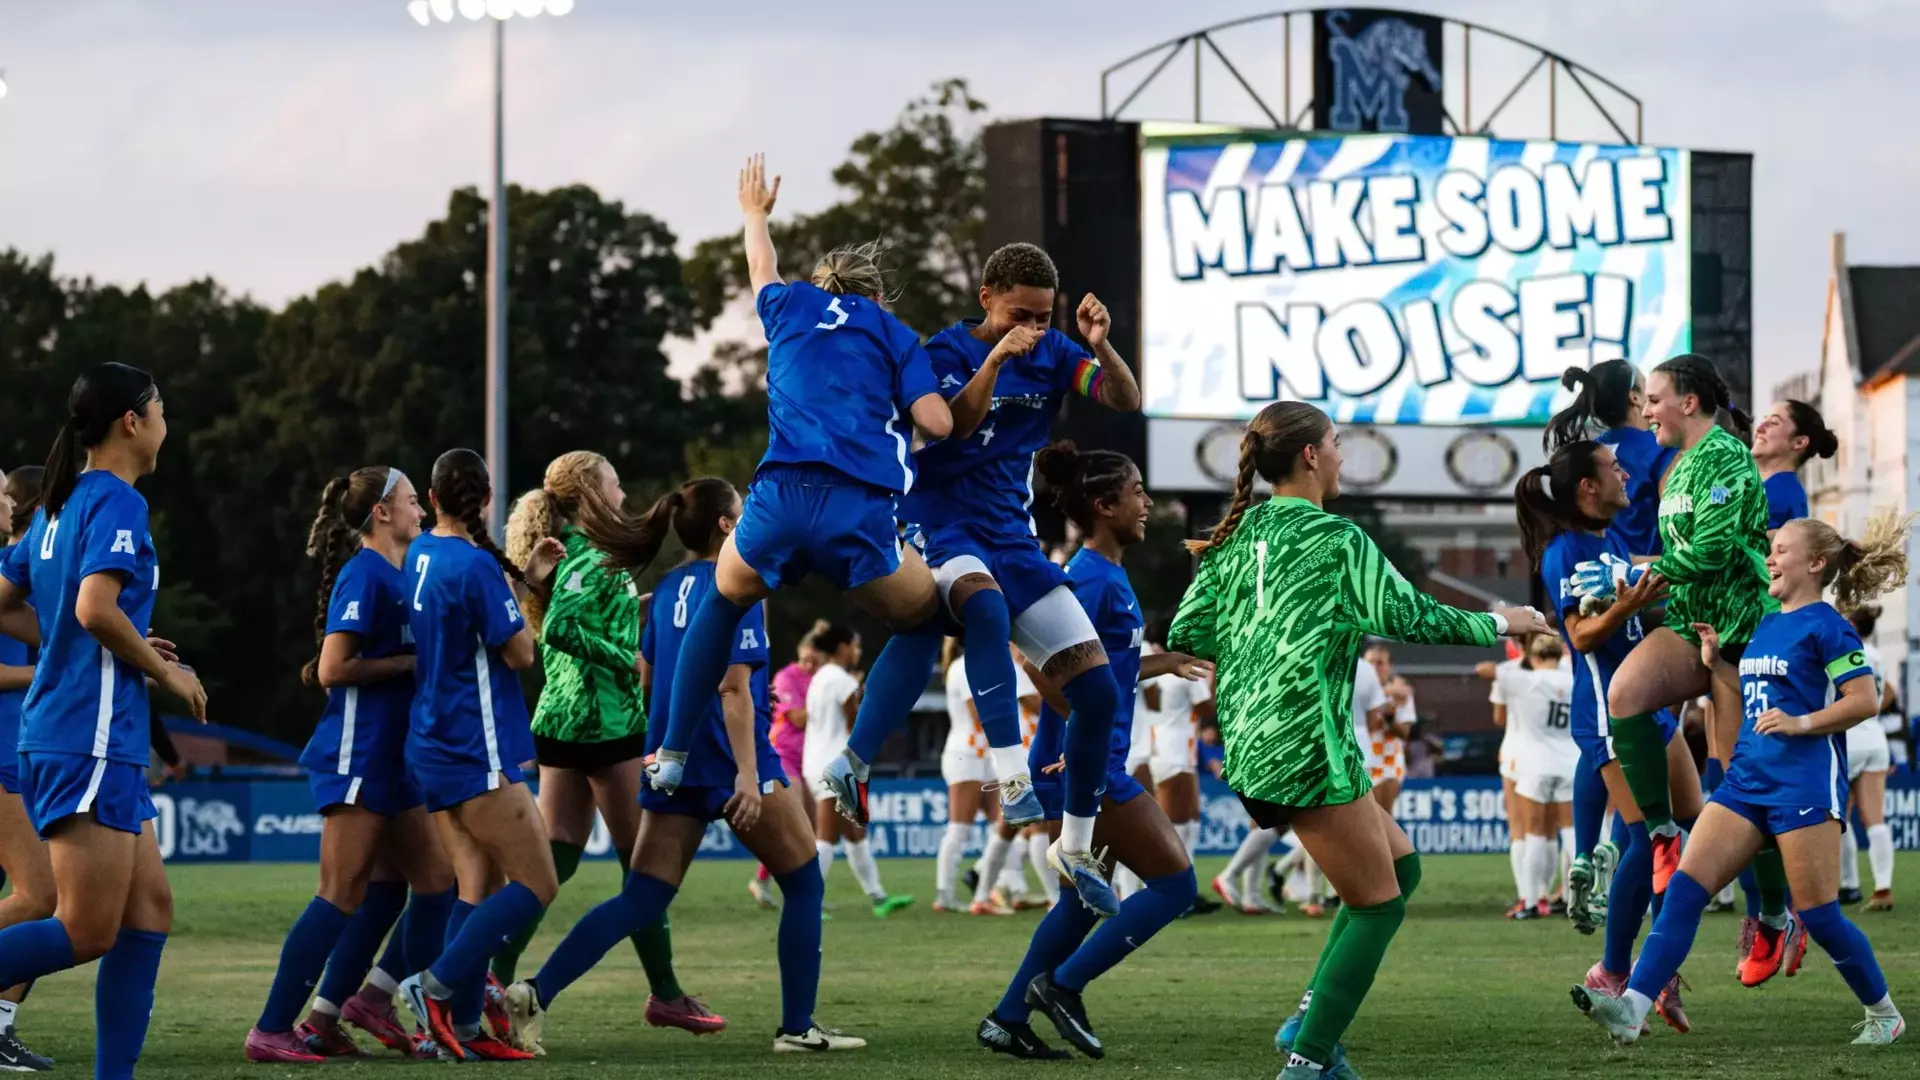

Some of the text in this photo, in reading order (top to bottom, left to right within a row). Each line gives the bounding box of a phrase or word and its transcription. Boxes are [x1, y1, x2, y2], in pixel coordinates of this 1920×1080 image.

[1167, 155, 1674, 281] MAKE SOME
[1236, 273, 1632, 401] NOISE!
[110, 529, 135, 554] A
[413, 553, 430, 612] 2
[1255, 540, 1267, 608] 1
[341, 600, 360, 621] A
[673, 576, 696, 628] 8
[740, 628, 759, 650] A
[1739, 654, 1789, 678] emphis
[1848, 651, 1865, 666] C
[1547, 700, 1570, 729] 16
[1744, 681, 1769, 718] 25
[868, 788, 947, 823] MEN'S
